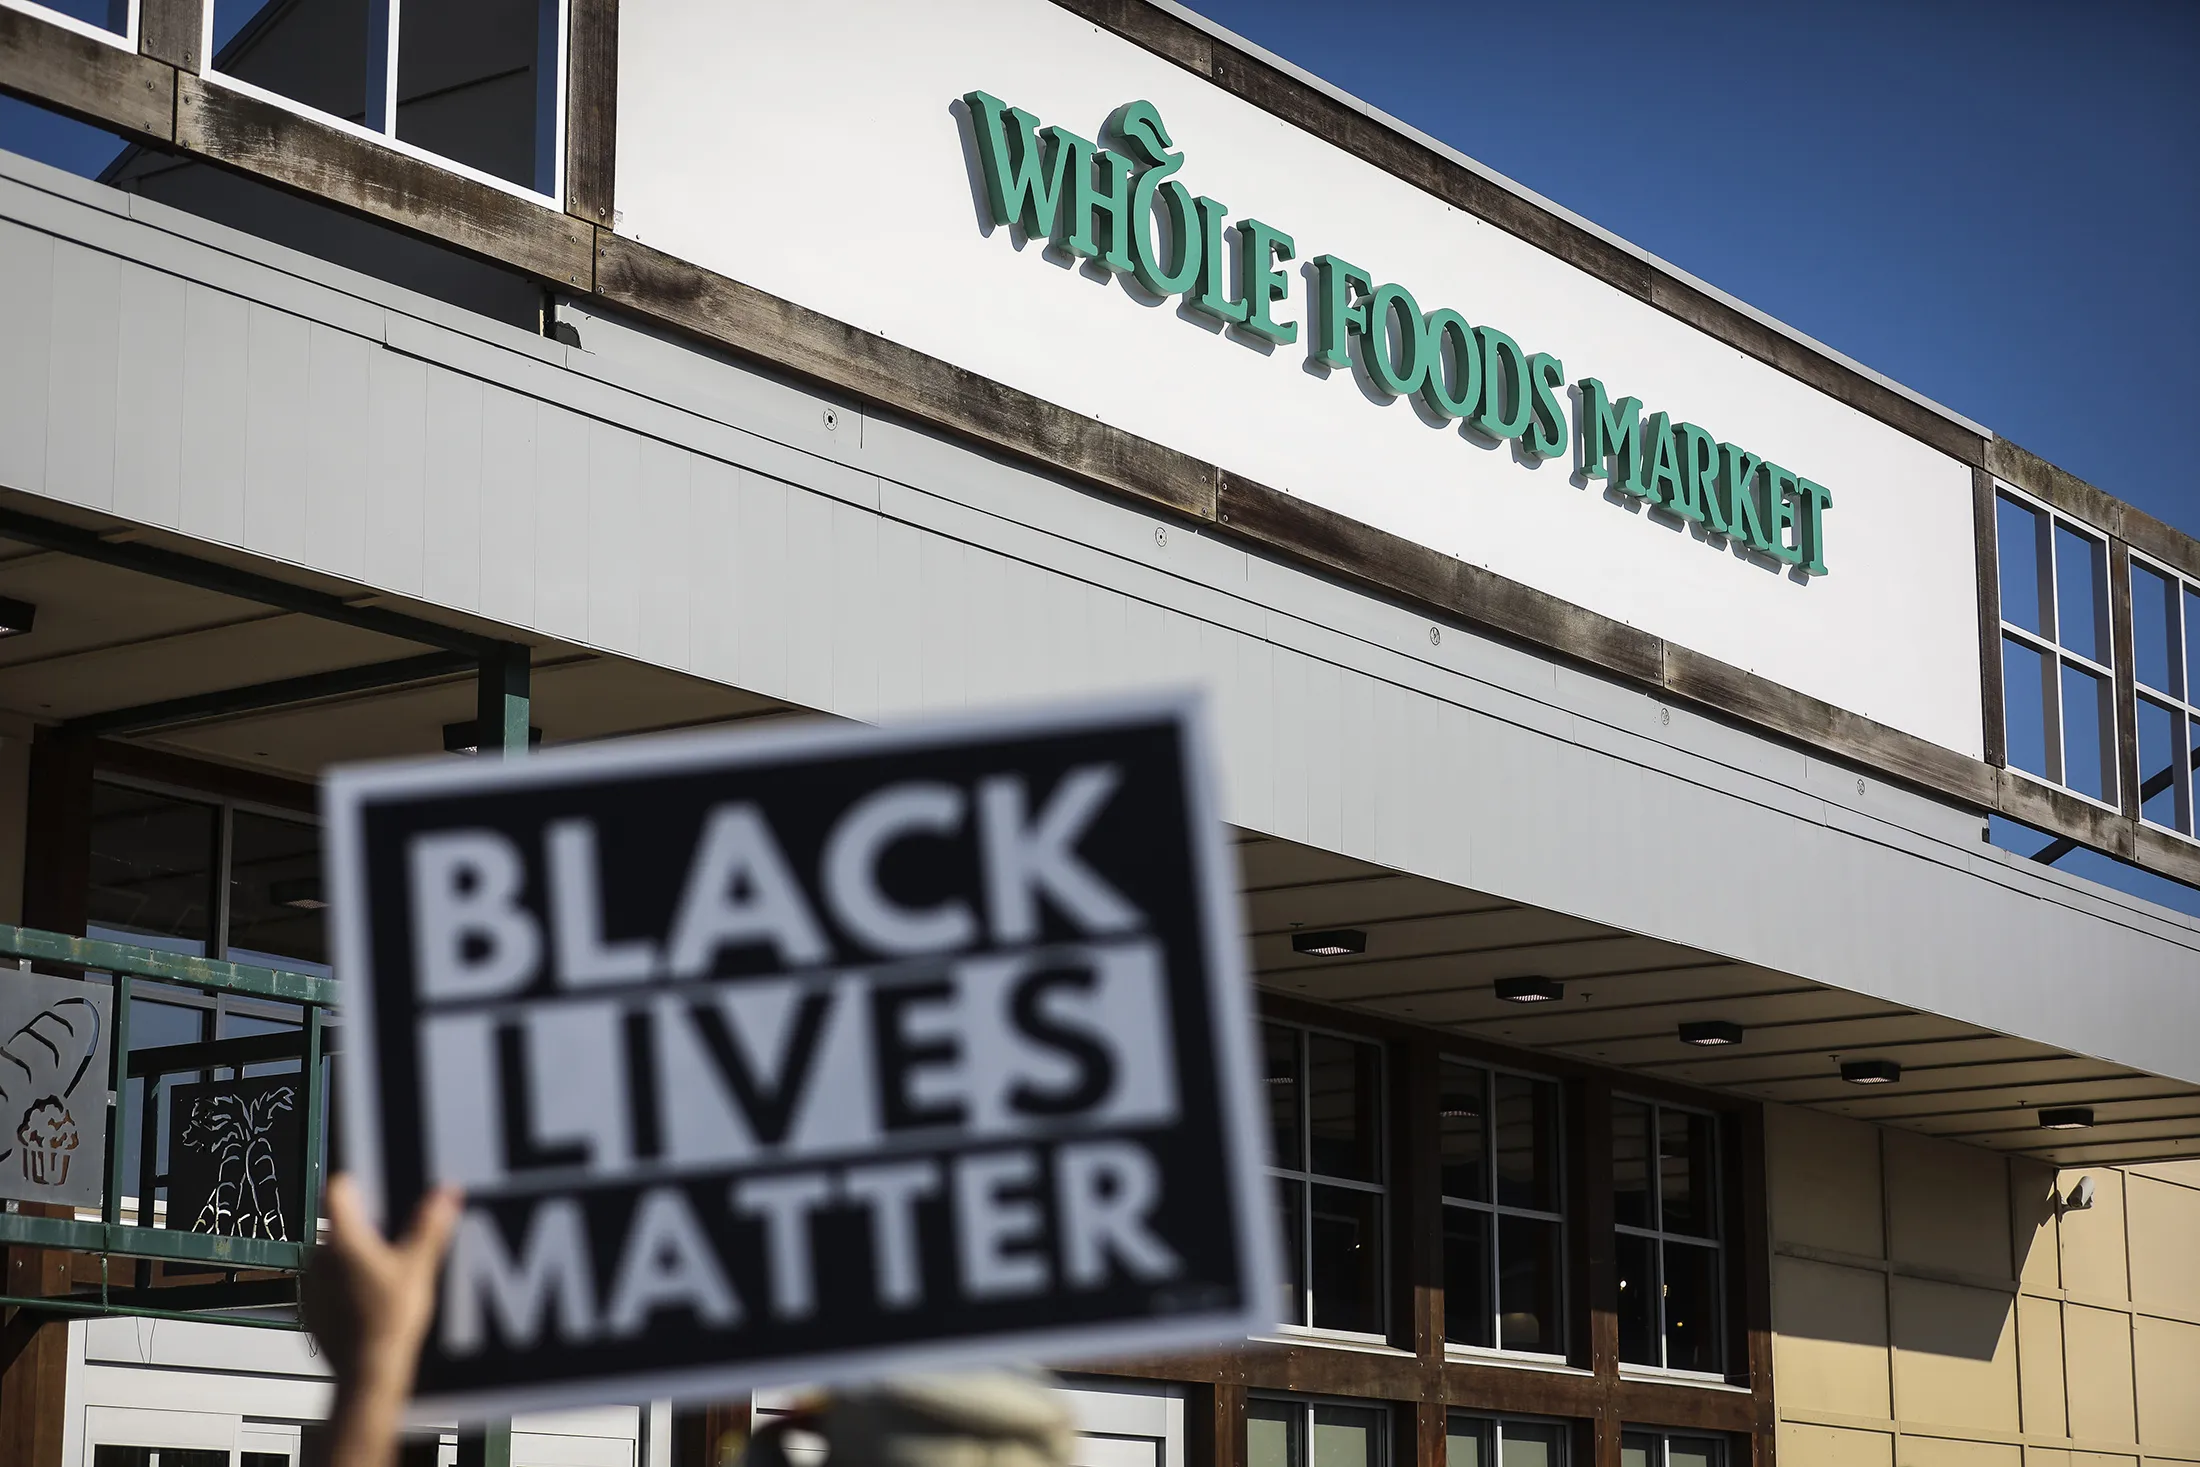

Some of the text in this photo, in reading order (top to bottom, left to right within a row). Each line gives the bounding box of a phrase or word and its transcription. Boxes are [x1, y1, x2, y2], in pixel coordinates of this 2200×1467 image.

[963, 90, 1834, 577] WHOLE FOODS MARKET
[409, 763, 1148, 998] BLACK
[492, 956, 1123, 1178] LIVES
[440, 1138, 1182, 1354] MATTER
